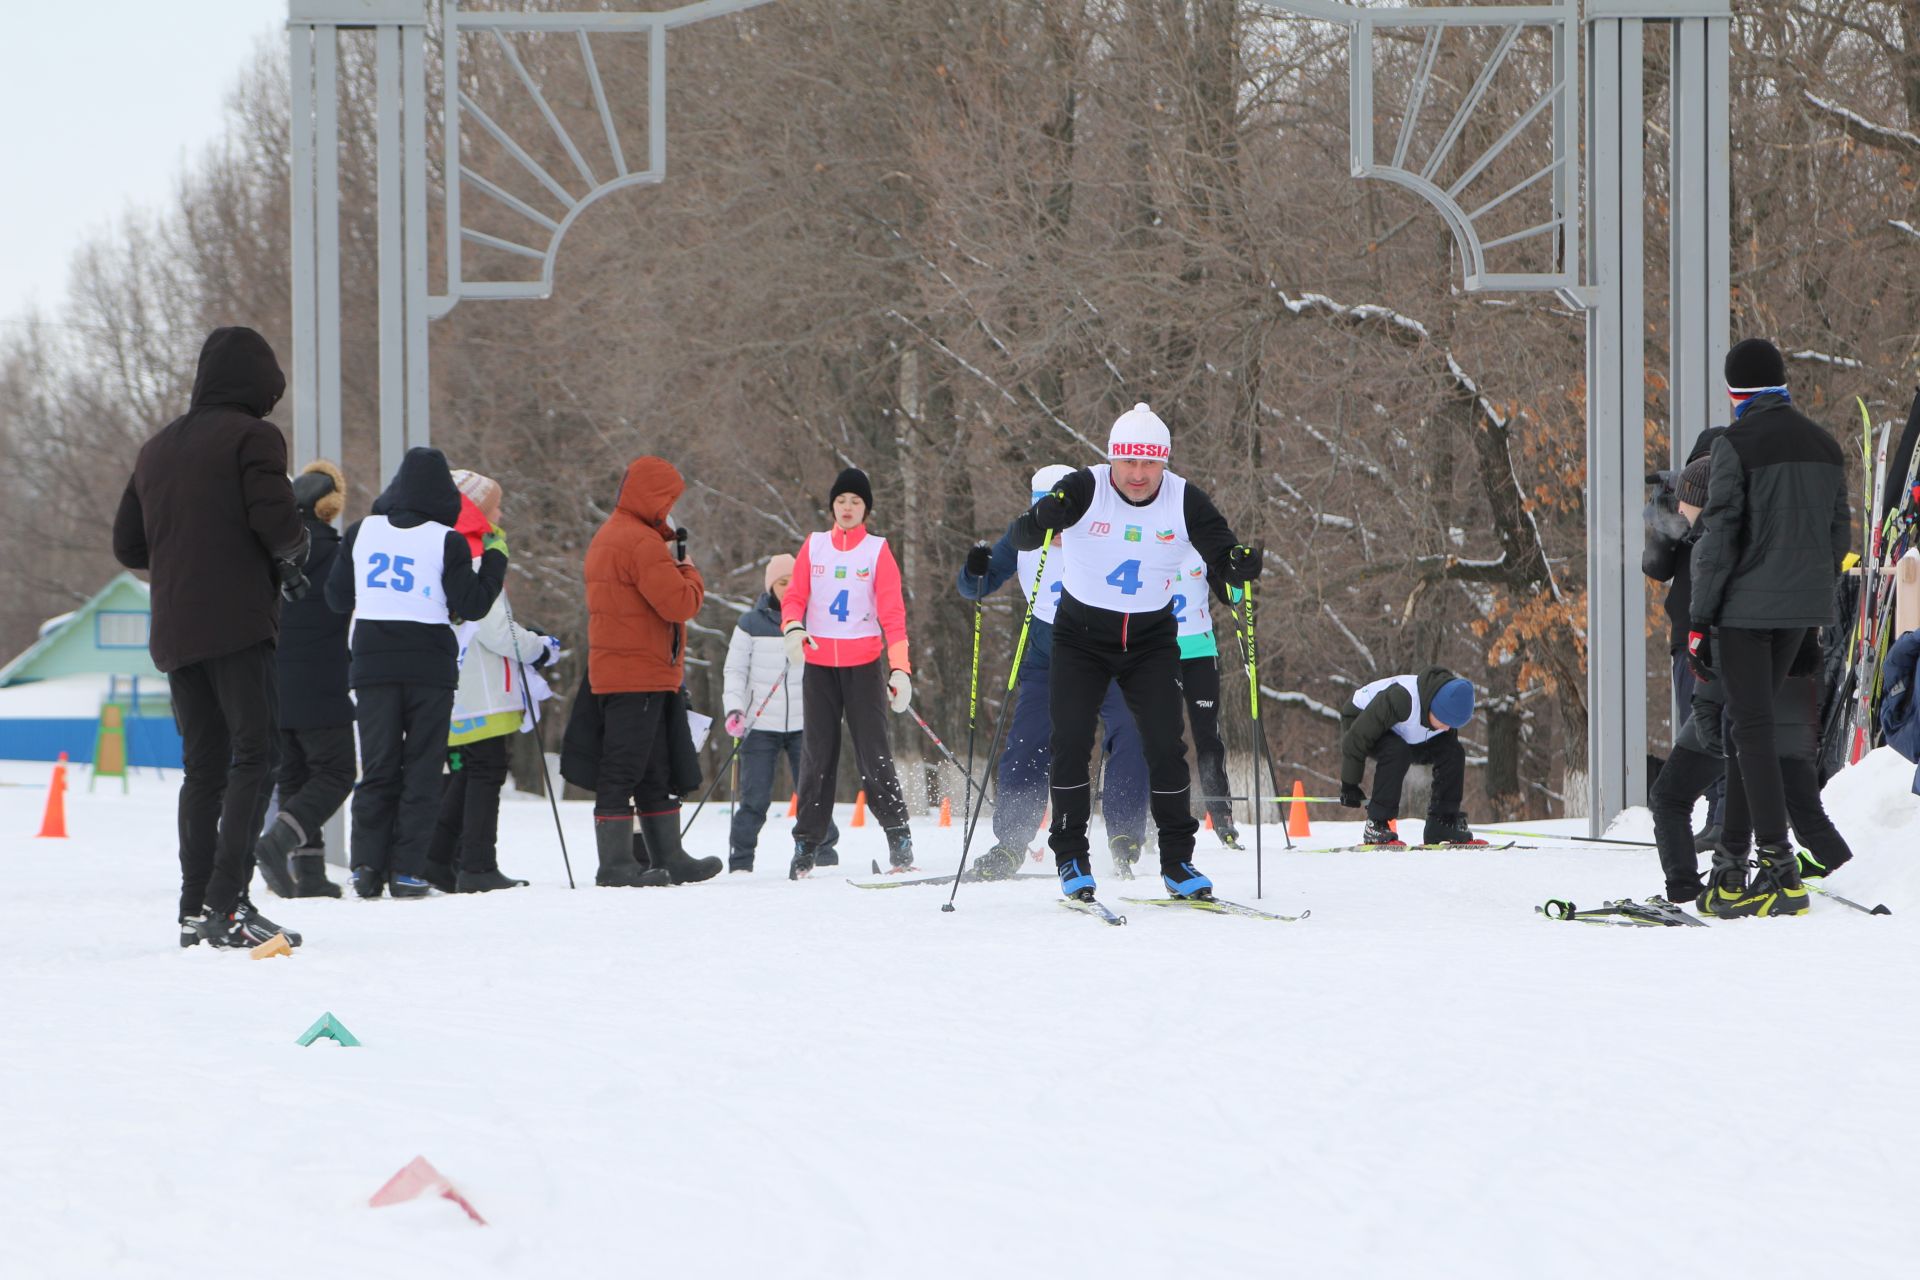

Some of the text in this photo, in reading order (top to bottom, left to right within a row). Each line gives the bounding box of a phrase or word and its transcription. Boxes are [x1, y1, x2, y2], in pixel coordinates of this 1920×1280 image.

[1112, 443, 1169, 458] RUSSIA
[367, 552, 414, 593] 25
[1105, 559, 1143, 595] 4
[829, 589, 849, 622] 4
[1171, 594, 1187, 622] 2
